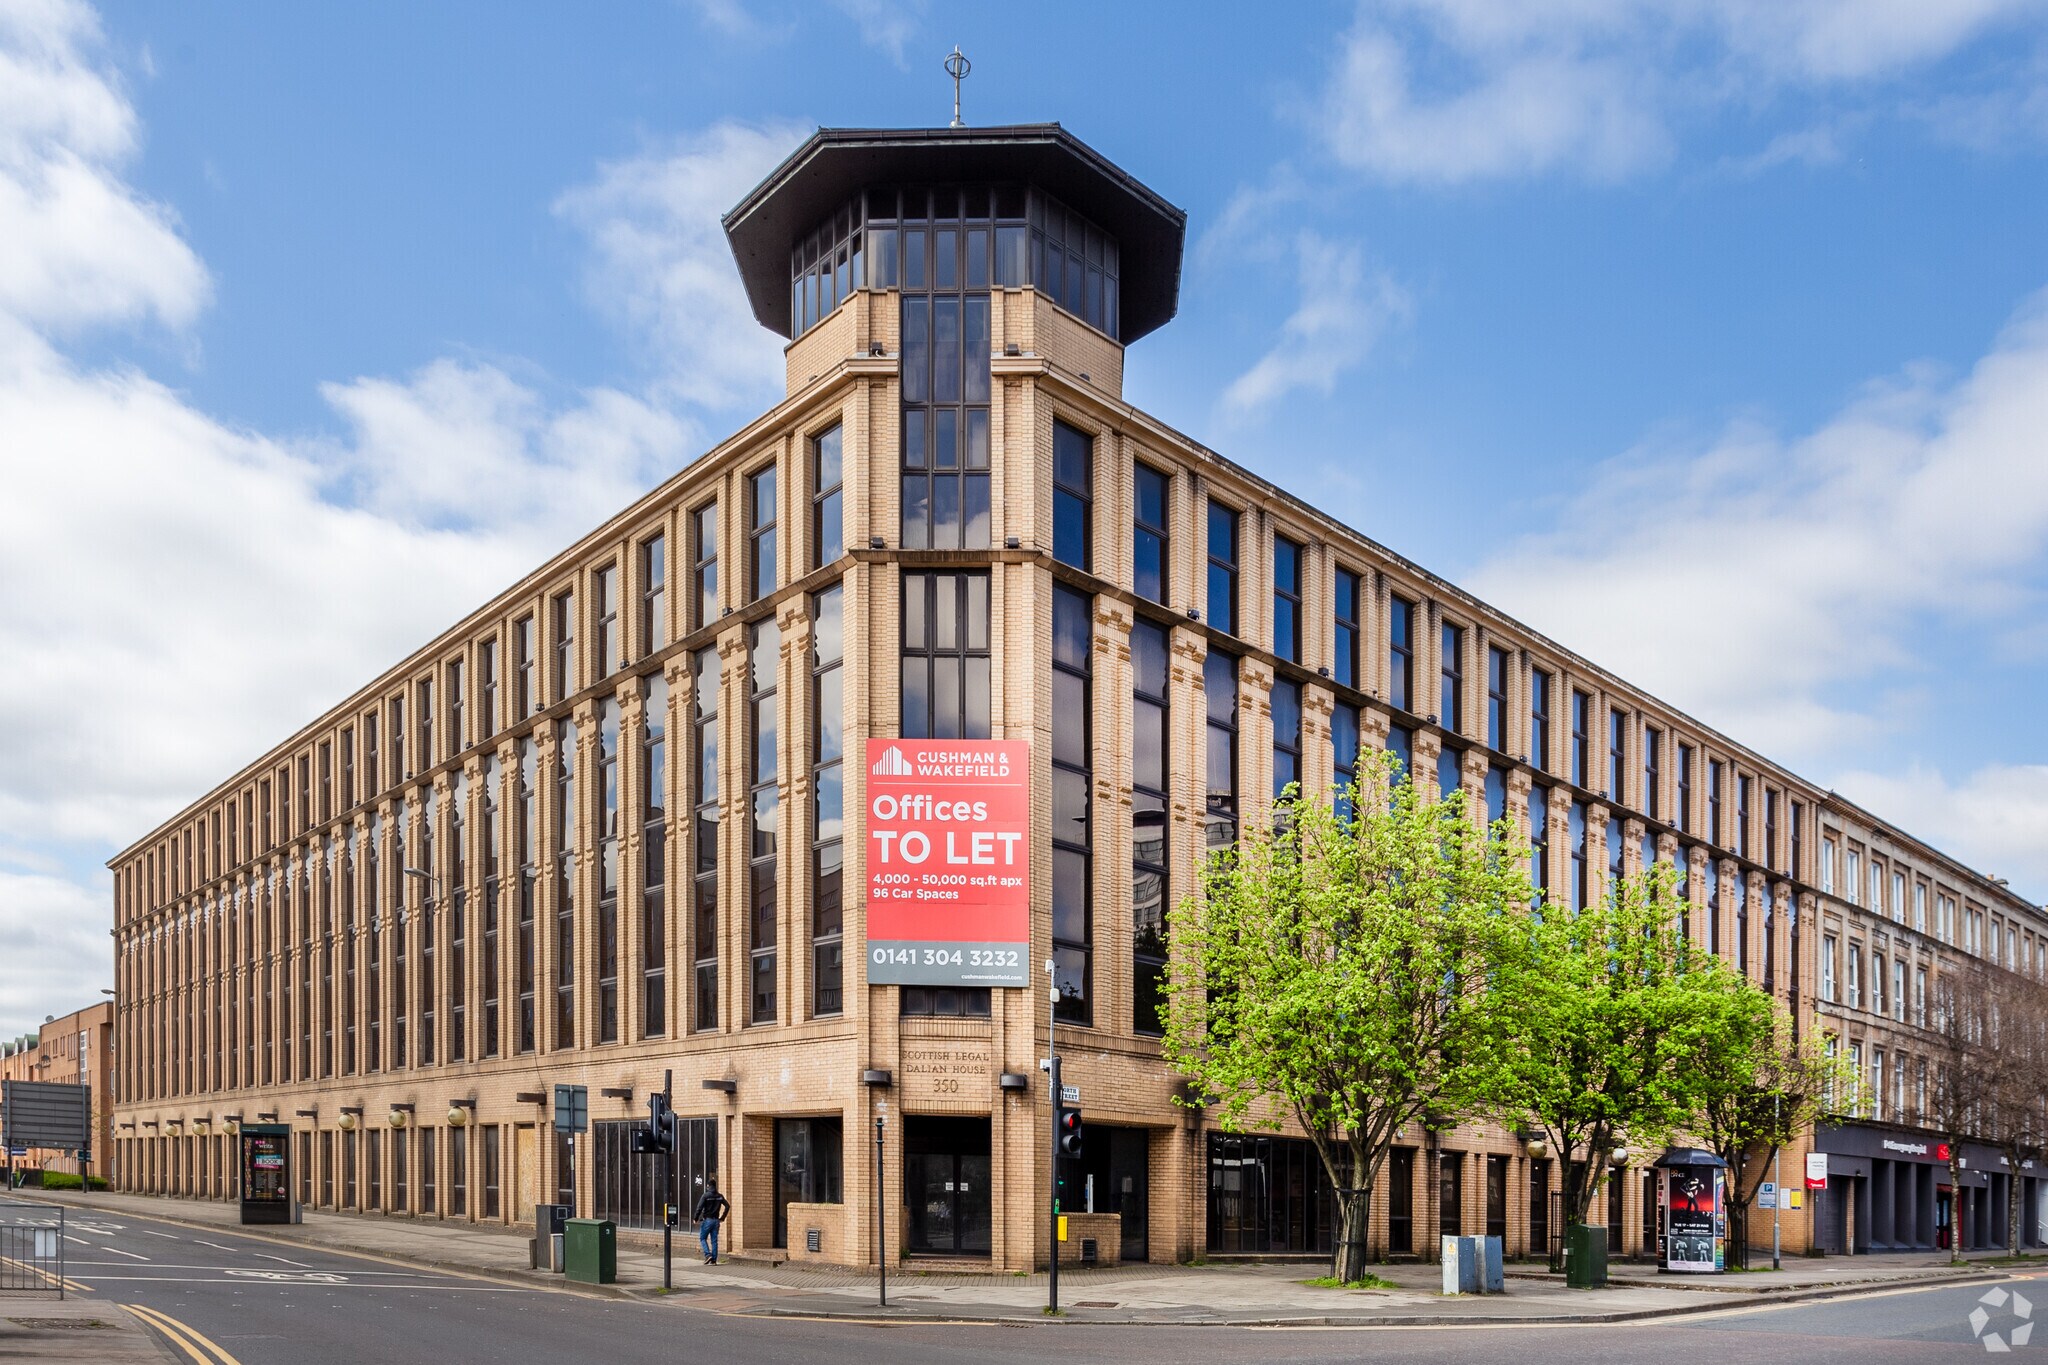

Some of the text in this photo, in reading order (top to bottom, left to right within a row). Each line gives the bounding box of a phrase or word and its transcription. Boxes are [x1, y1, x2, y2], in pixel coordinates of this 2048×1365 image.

[917, 751, 1009, 764] CUSHMAN &
[917, 764, 1010, 778] WAKEFIELD
[872, 794, 988, 821] Offices
[873, 830, 1022, 865] TO LET
[873, 874, 910, 886] 4,000
[922, 874, 967, 887] 50,000
[970, 874, 997, 888] sq.ft
[1000, 877, 1023, 887] apx
[873, 888, 959, 901] 96 Car Spaces
[872, 948, 1019, 967] 0141 304 3232
[902, 1050, 990, 1061] SCOTTISH LEGAL
[906, 1064, 986, 1074] DALIAN HOUSE
[933, 1078, 959, 1093] 350
